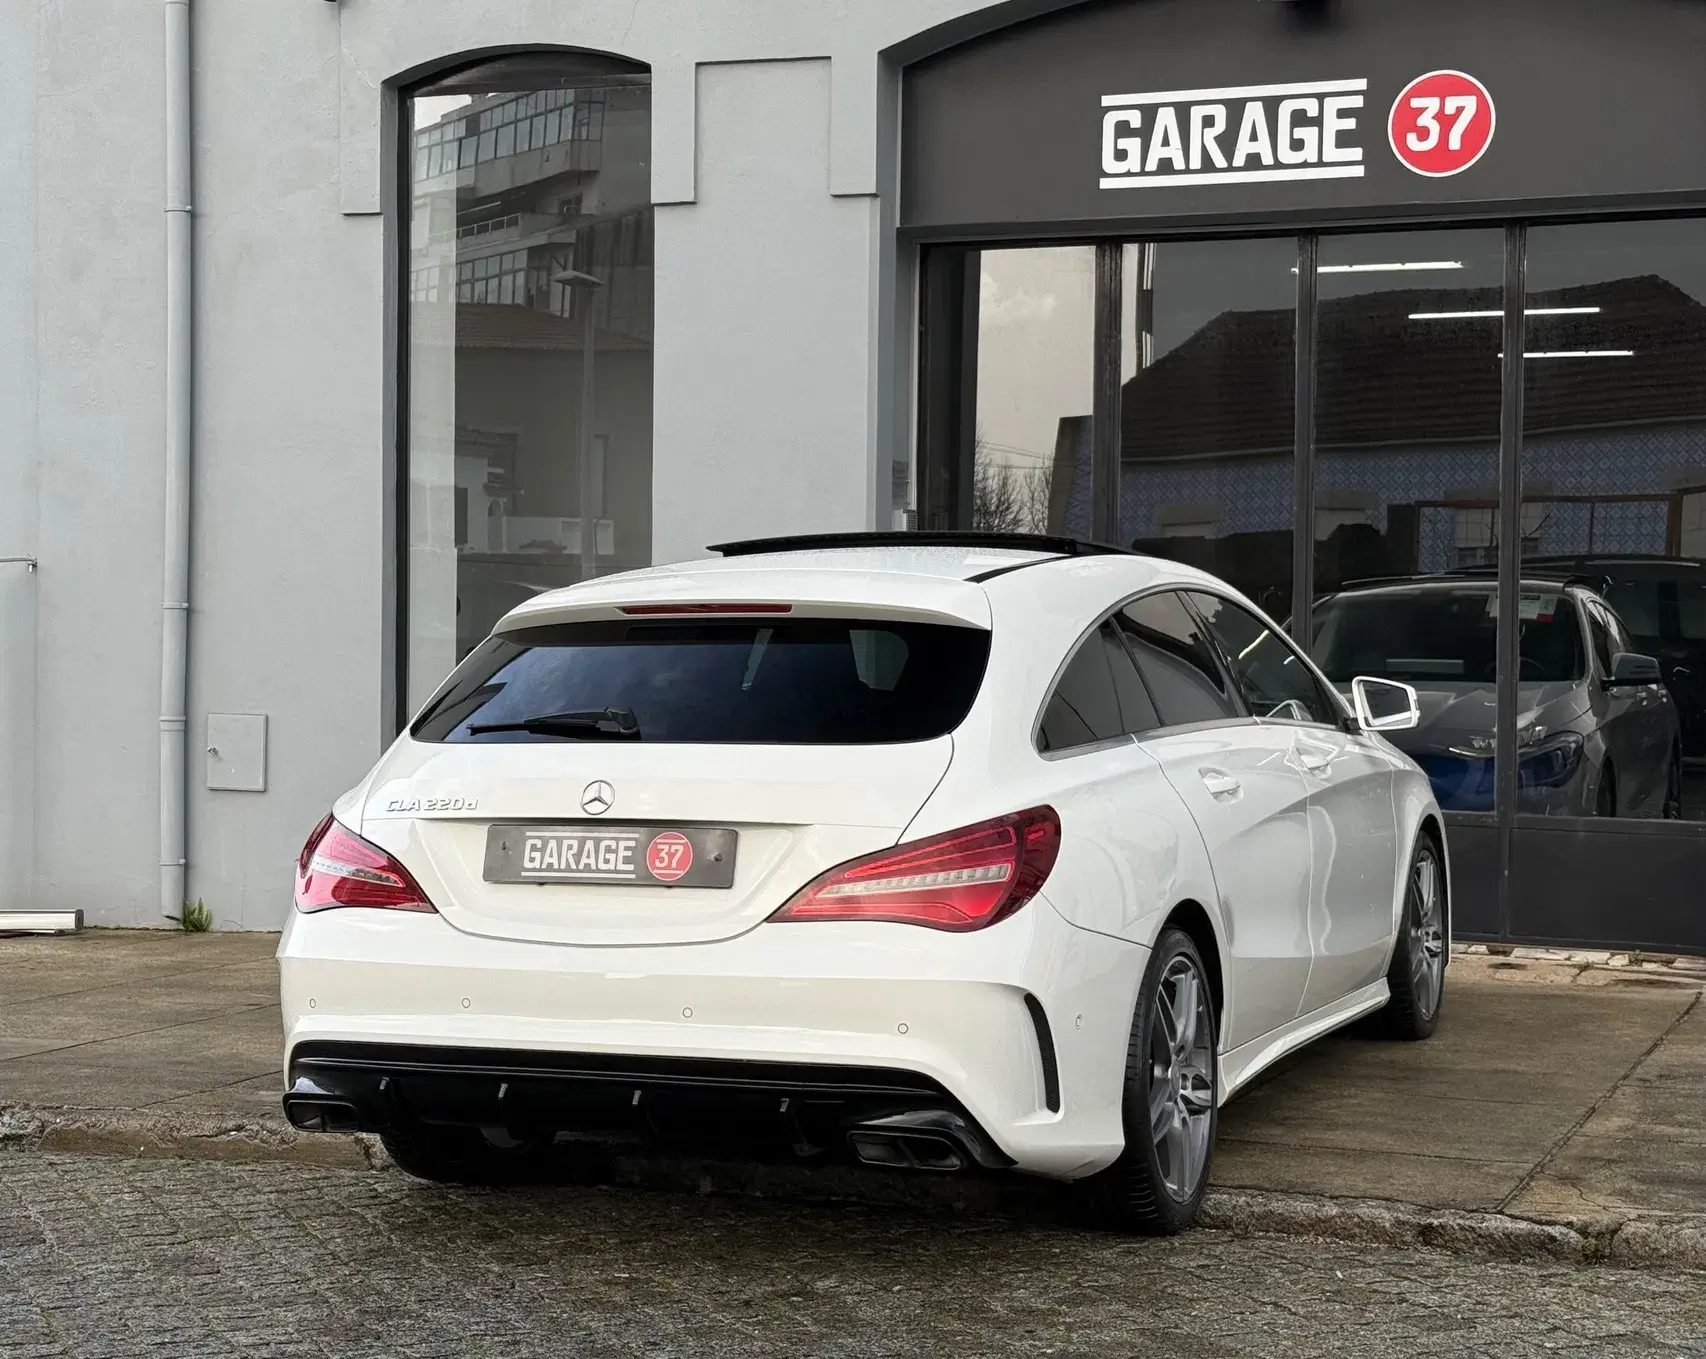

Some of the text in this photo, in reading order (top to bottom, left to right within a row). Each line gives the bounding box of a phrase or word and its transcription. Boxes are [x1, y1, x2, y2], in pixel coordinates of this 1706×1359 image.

[1101, 95, 1478, 174] GARAGE 37
[385, 798, 421, 812] CLA
[523, 838, 684, 871] GARAGE 37
